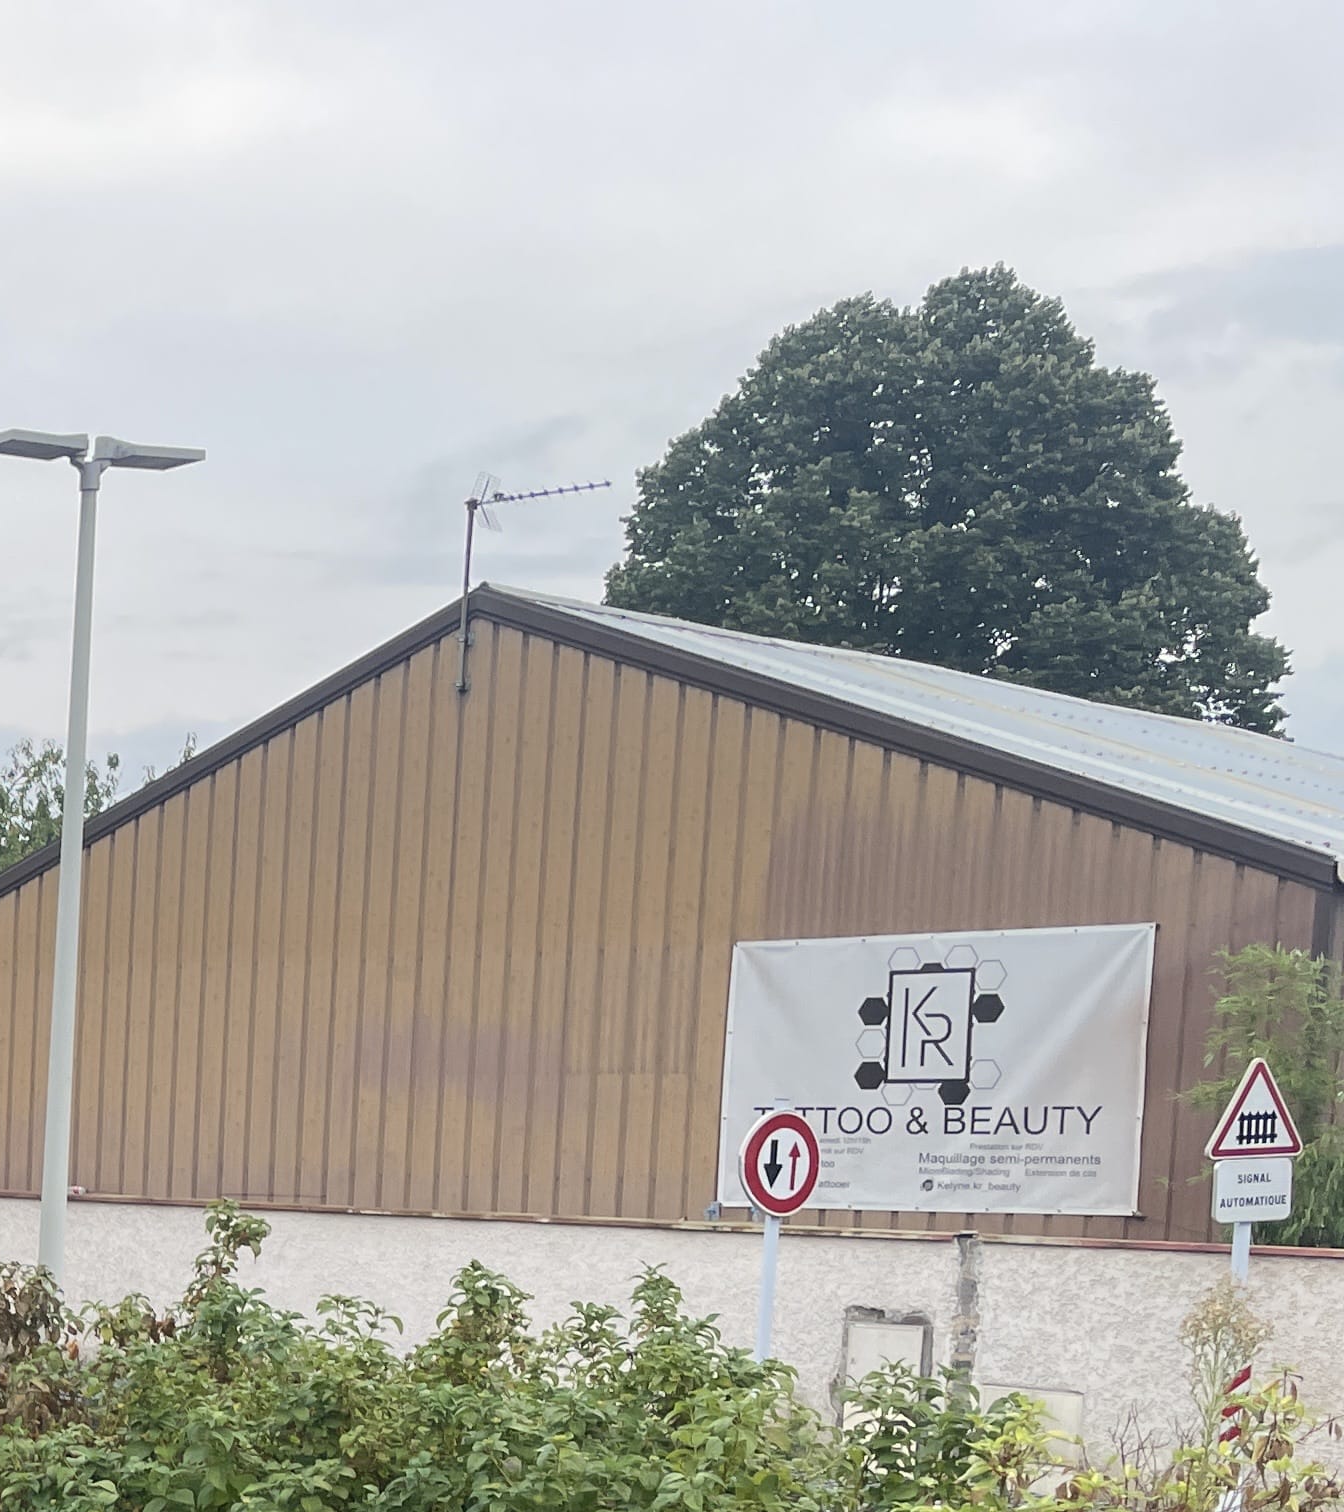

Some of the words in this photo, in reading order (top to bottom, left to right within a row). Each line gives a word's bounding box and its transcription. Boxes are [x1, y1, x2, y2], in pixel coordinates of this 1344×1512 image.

[753, 1106, 893, 1136] TTTOO
[905, 1106, 929, 1136] &
[943, 1105, 1103, 1136] BEAUTY
[918, 1152, 986, 1167] Maquillage
[989, 1154, 1102, 1167] semi-permanents
[1237, 1173, 1272, 1185] SIGNAL
[1219, 1194, 1288, 1209] AUTOMATIQUE
